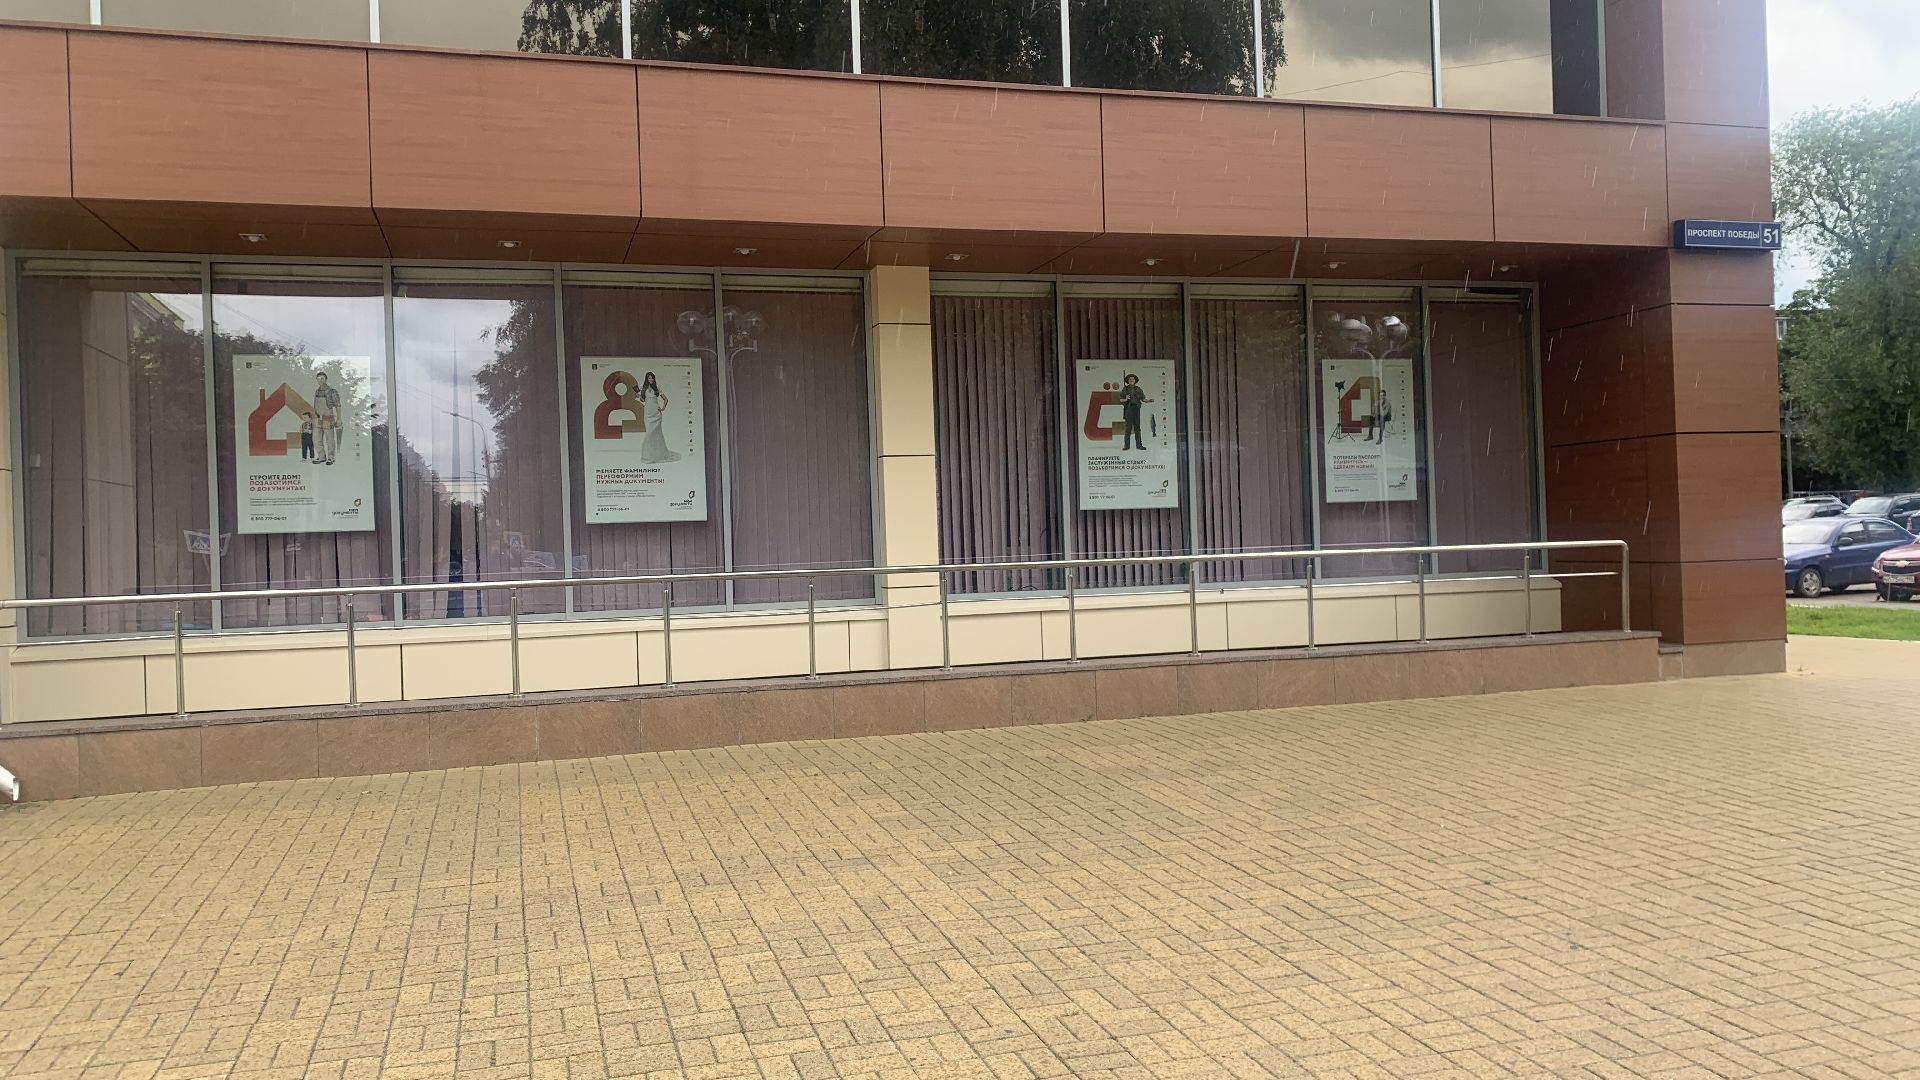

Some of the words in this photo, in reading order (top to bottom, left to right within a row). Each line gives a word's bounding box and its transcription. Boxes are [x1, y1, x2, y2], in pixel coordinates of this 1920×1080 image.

[1687, 229, 1726, 238] ПРОСПЕКТ
[1727, 230, 1760, 240] ПОБЕДЫ
[1763, 228, 1779, 244] 51
